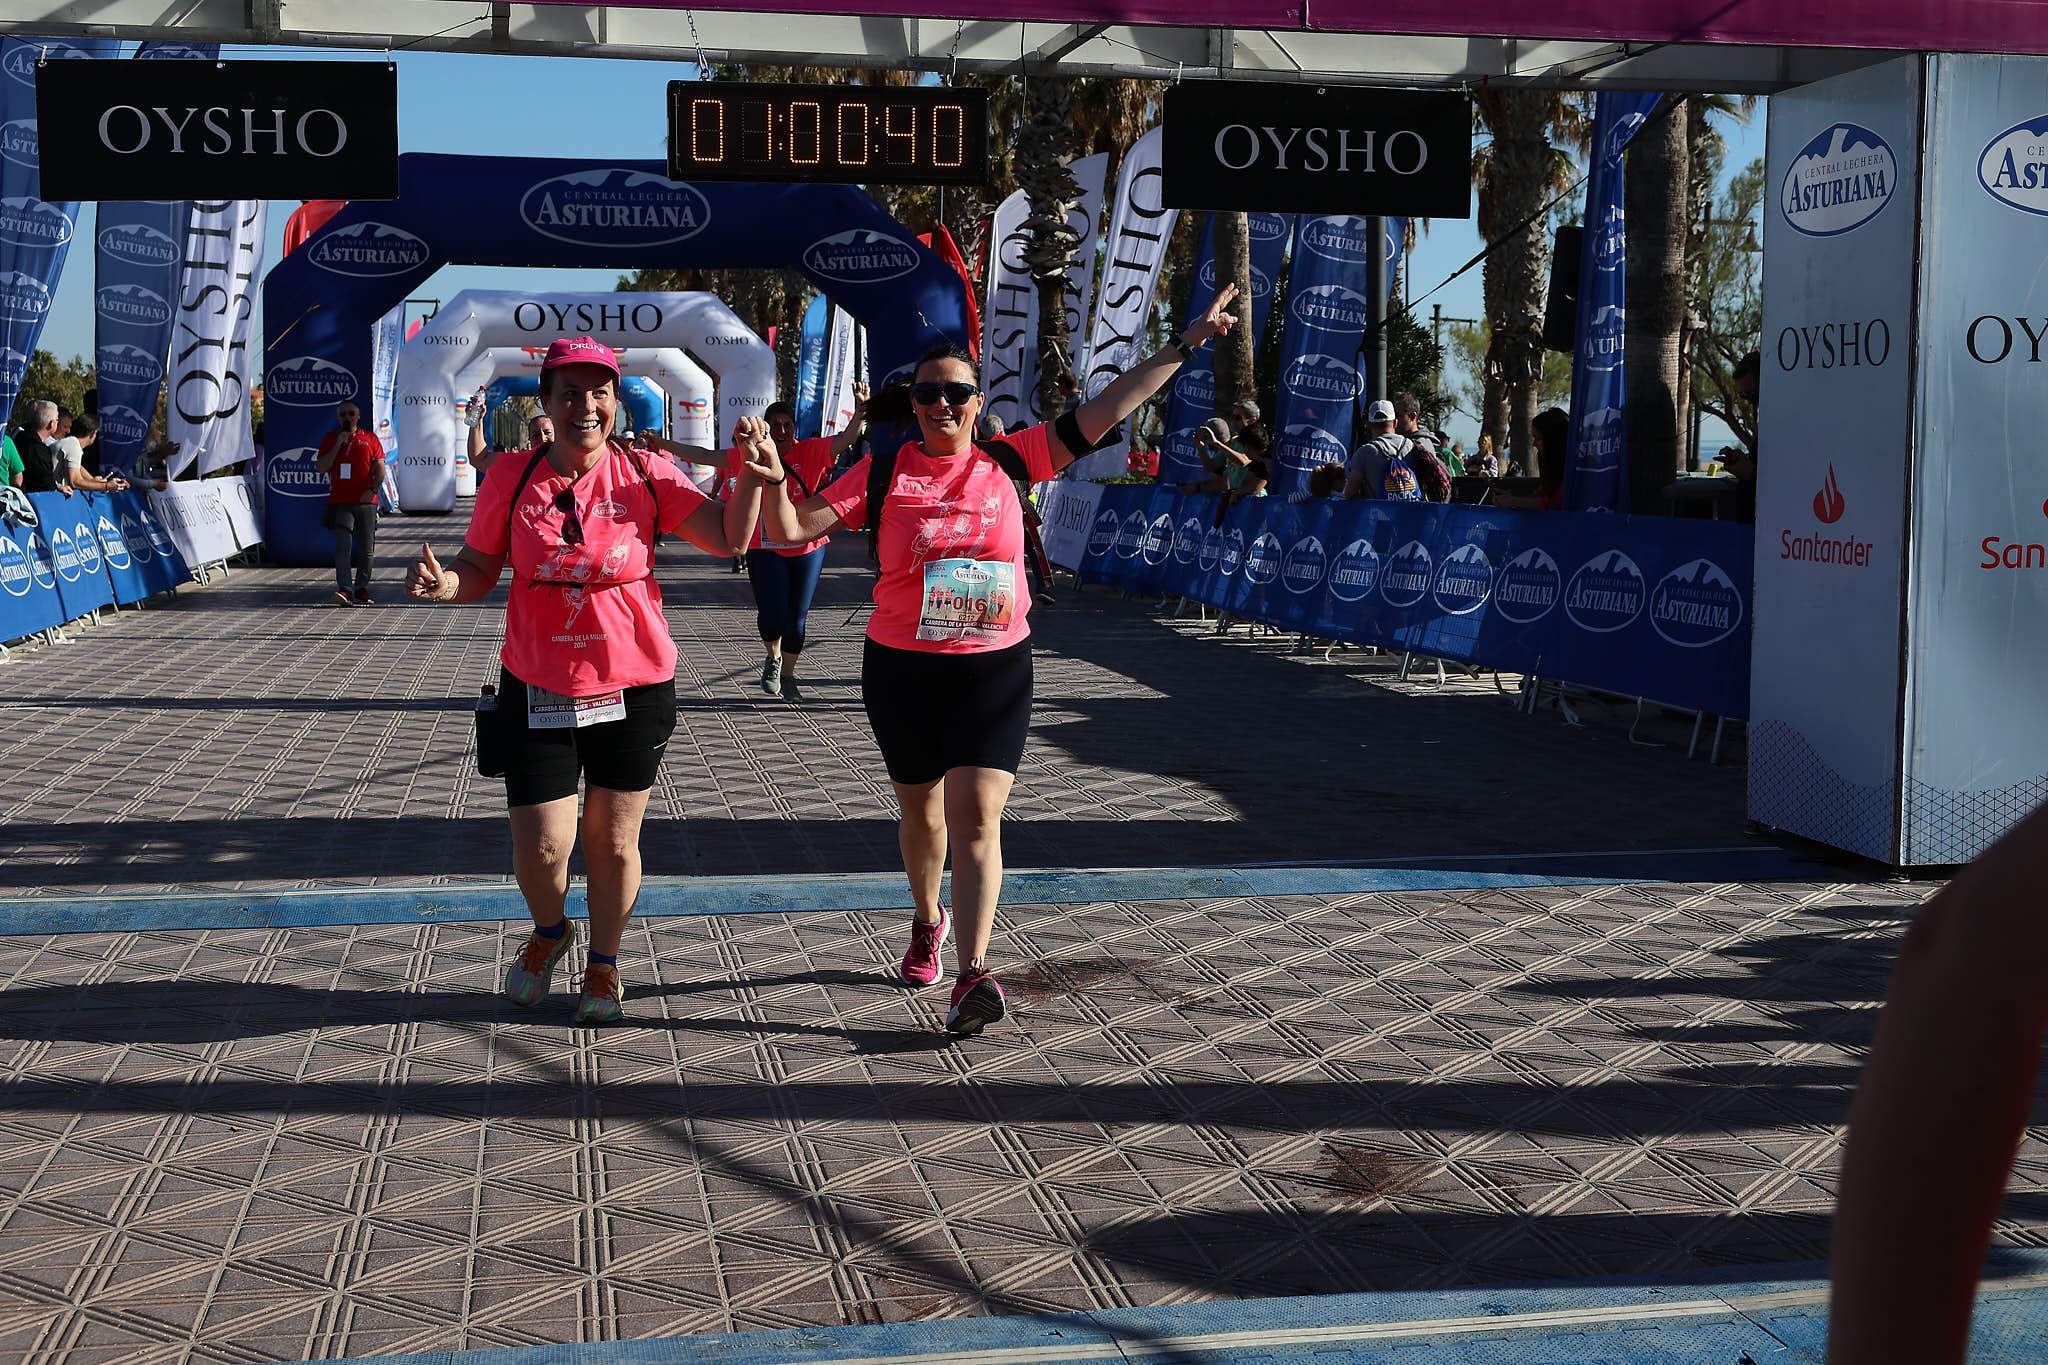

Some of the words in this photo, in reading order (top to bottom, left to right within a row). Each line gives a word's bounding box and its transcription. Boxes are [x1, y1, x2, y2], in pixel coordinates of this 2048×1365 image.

[98, 105, 348, 157] OYSHO
[1214, 124, 1428, 175] OYSHO
[1805, 163, 1840, 179] CENTRAL
[1844, 154, 1884, 170] LECHERA
[564, 191, 623, 201] CENTRAL
[631, 192, 691, 201] LECHERA
[1788, 169, 1887, 214] ASTURIANA
[535, 191, 698, 228] ASTURIANA
[104, 233, 174, 261] ASTURIANA
[315, 242, 421, 264] ASTURIANA
[814, 250, 914, 271] ASTURIANA
[514, 302, 663, 333] OYSHO
[424, 335, 469, 346] OYSHO
[705, 336, 749, 345] OYSHO
[1777, 318, 1890, 371] OYSHO
[270, 375, 352, 395] ASTURIANA
[404, 395, 447, 405] OYSHO
[729, 397, 769, 407] OYSHO
[404, 456, 446, 466] OYSHO
[1780, 528, 1873, 567] Santander
[1568, 576, 1638, 615] ASTURIANA
[1655, 585, 1730, 629] ASTURIANA
